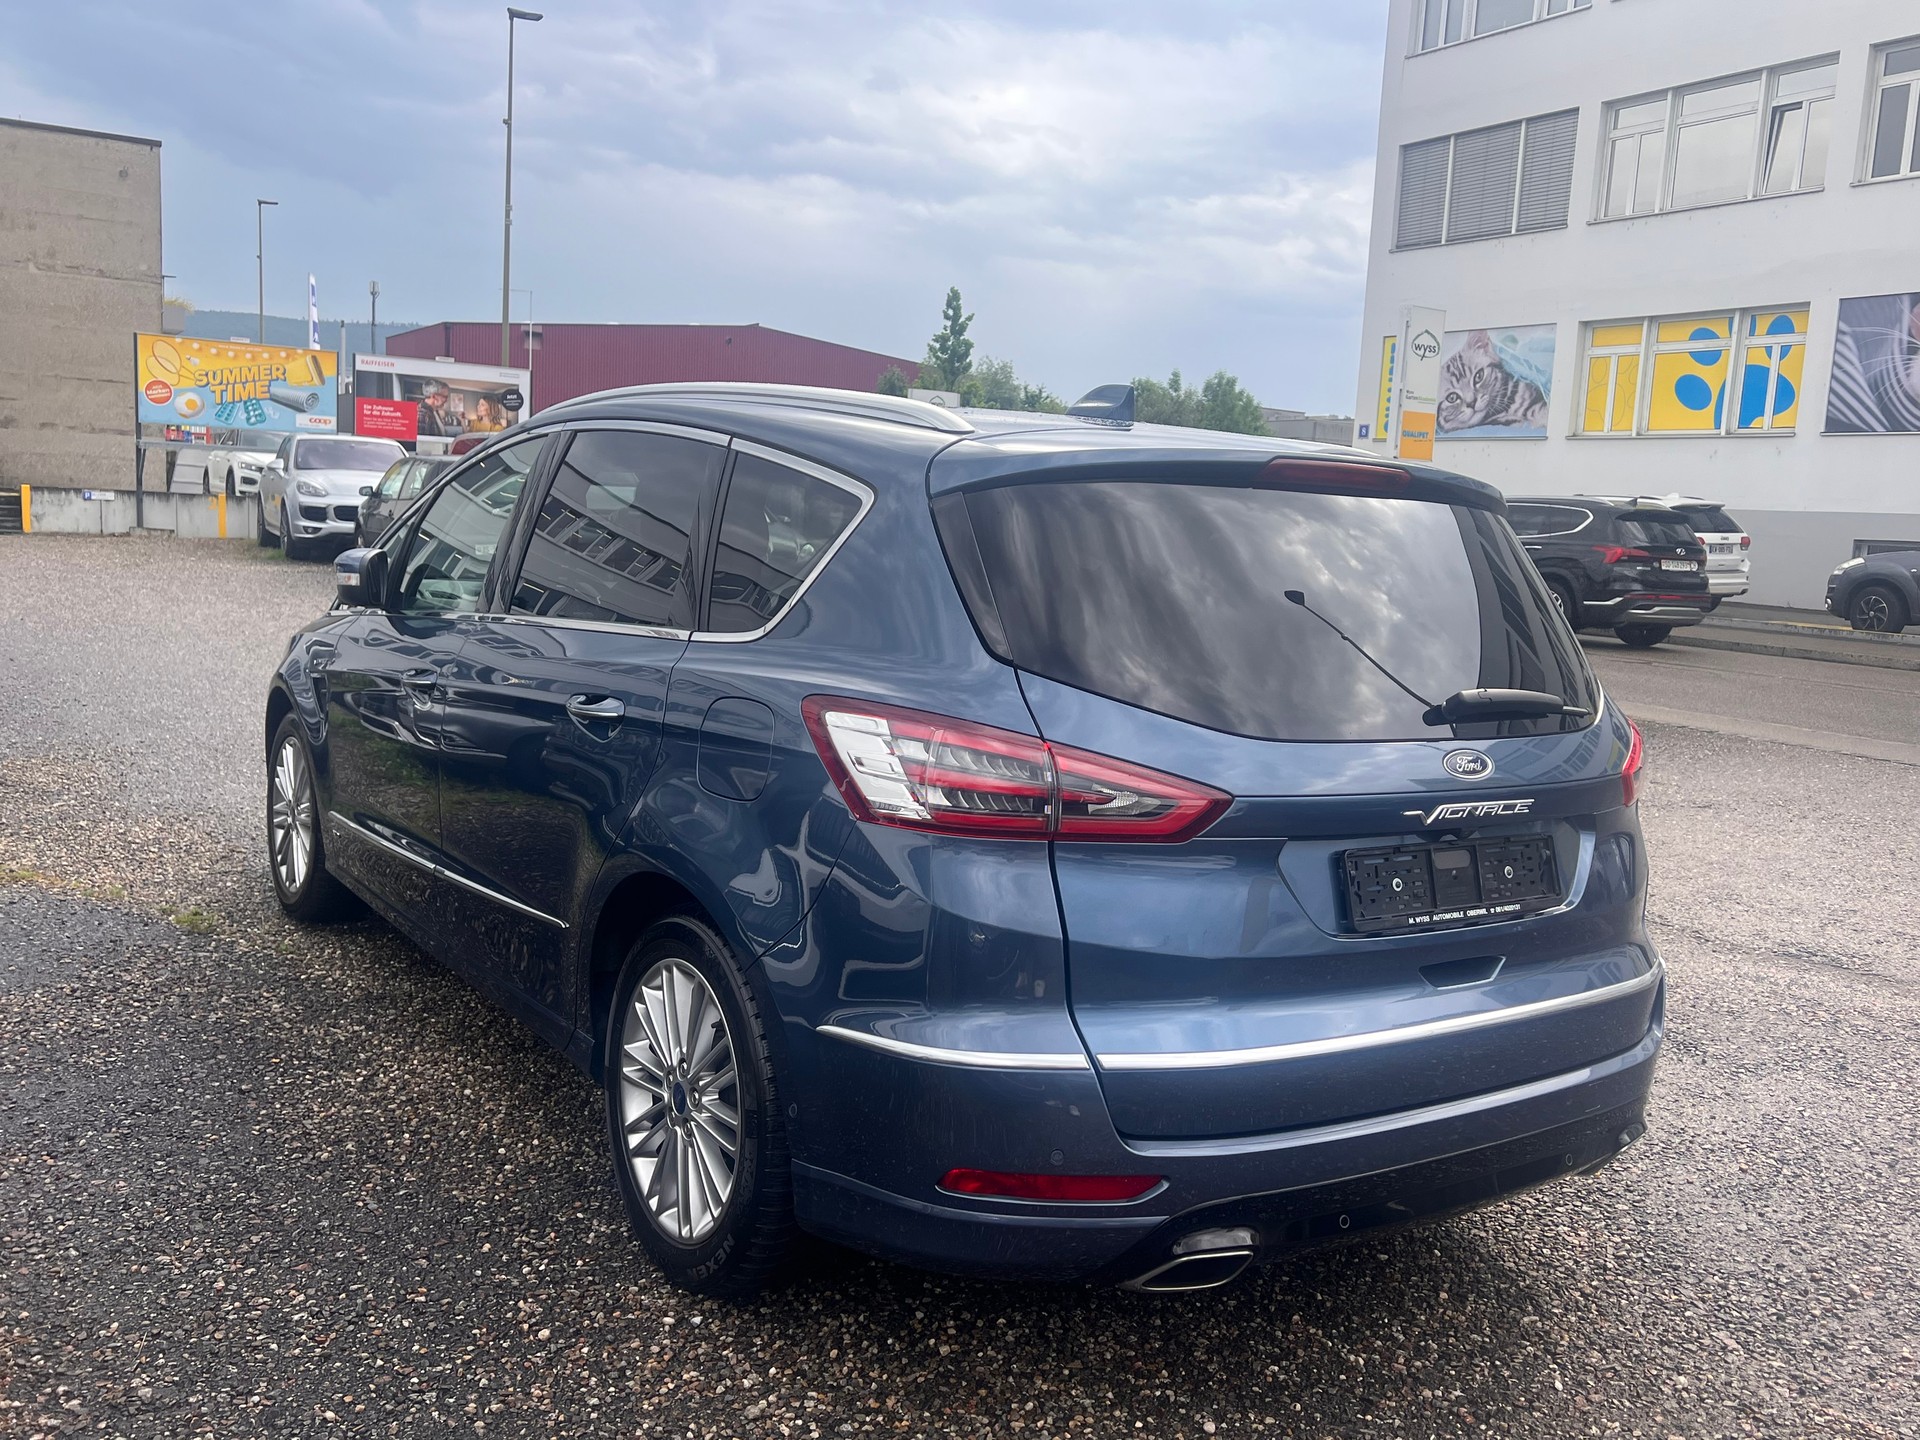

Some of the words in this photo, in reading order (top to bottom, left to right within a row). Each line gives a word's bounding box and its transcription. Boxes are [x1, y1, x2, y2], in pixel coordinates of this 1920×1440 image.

[1414, 343, 1437, 361] wyss
[361, 358, 395, 368] RAIFFEISEN
[194, 364, 286, 387] SUMMER
[210, 380, 270, 404] TIME
[1402, 430, 1430, 439] QUALIPET
[1456, 755, 1483, 773] Ford
[1403, 799, 1535, 826] VIGNALE
[1416, 915, 1431, 924] WYSS
[1433, 911, 1465, 921] AUTOMOBILE
[1466, 908, 1489, 917] OBERWIL
